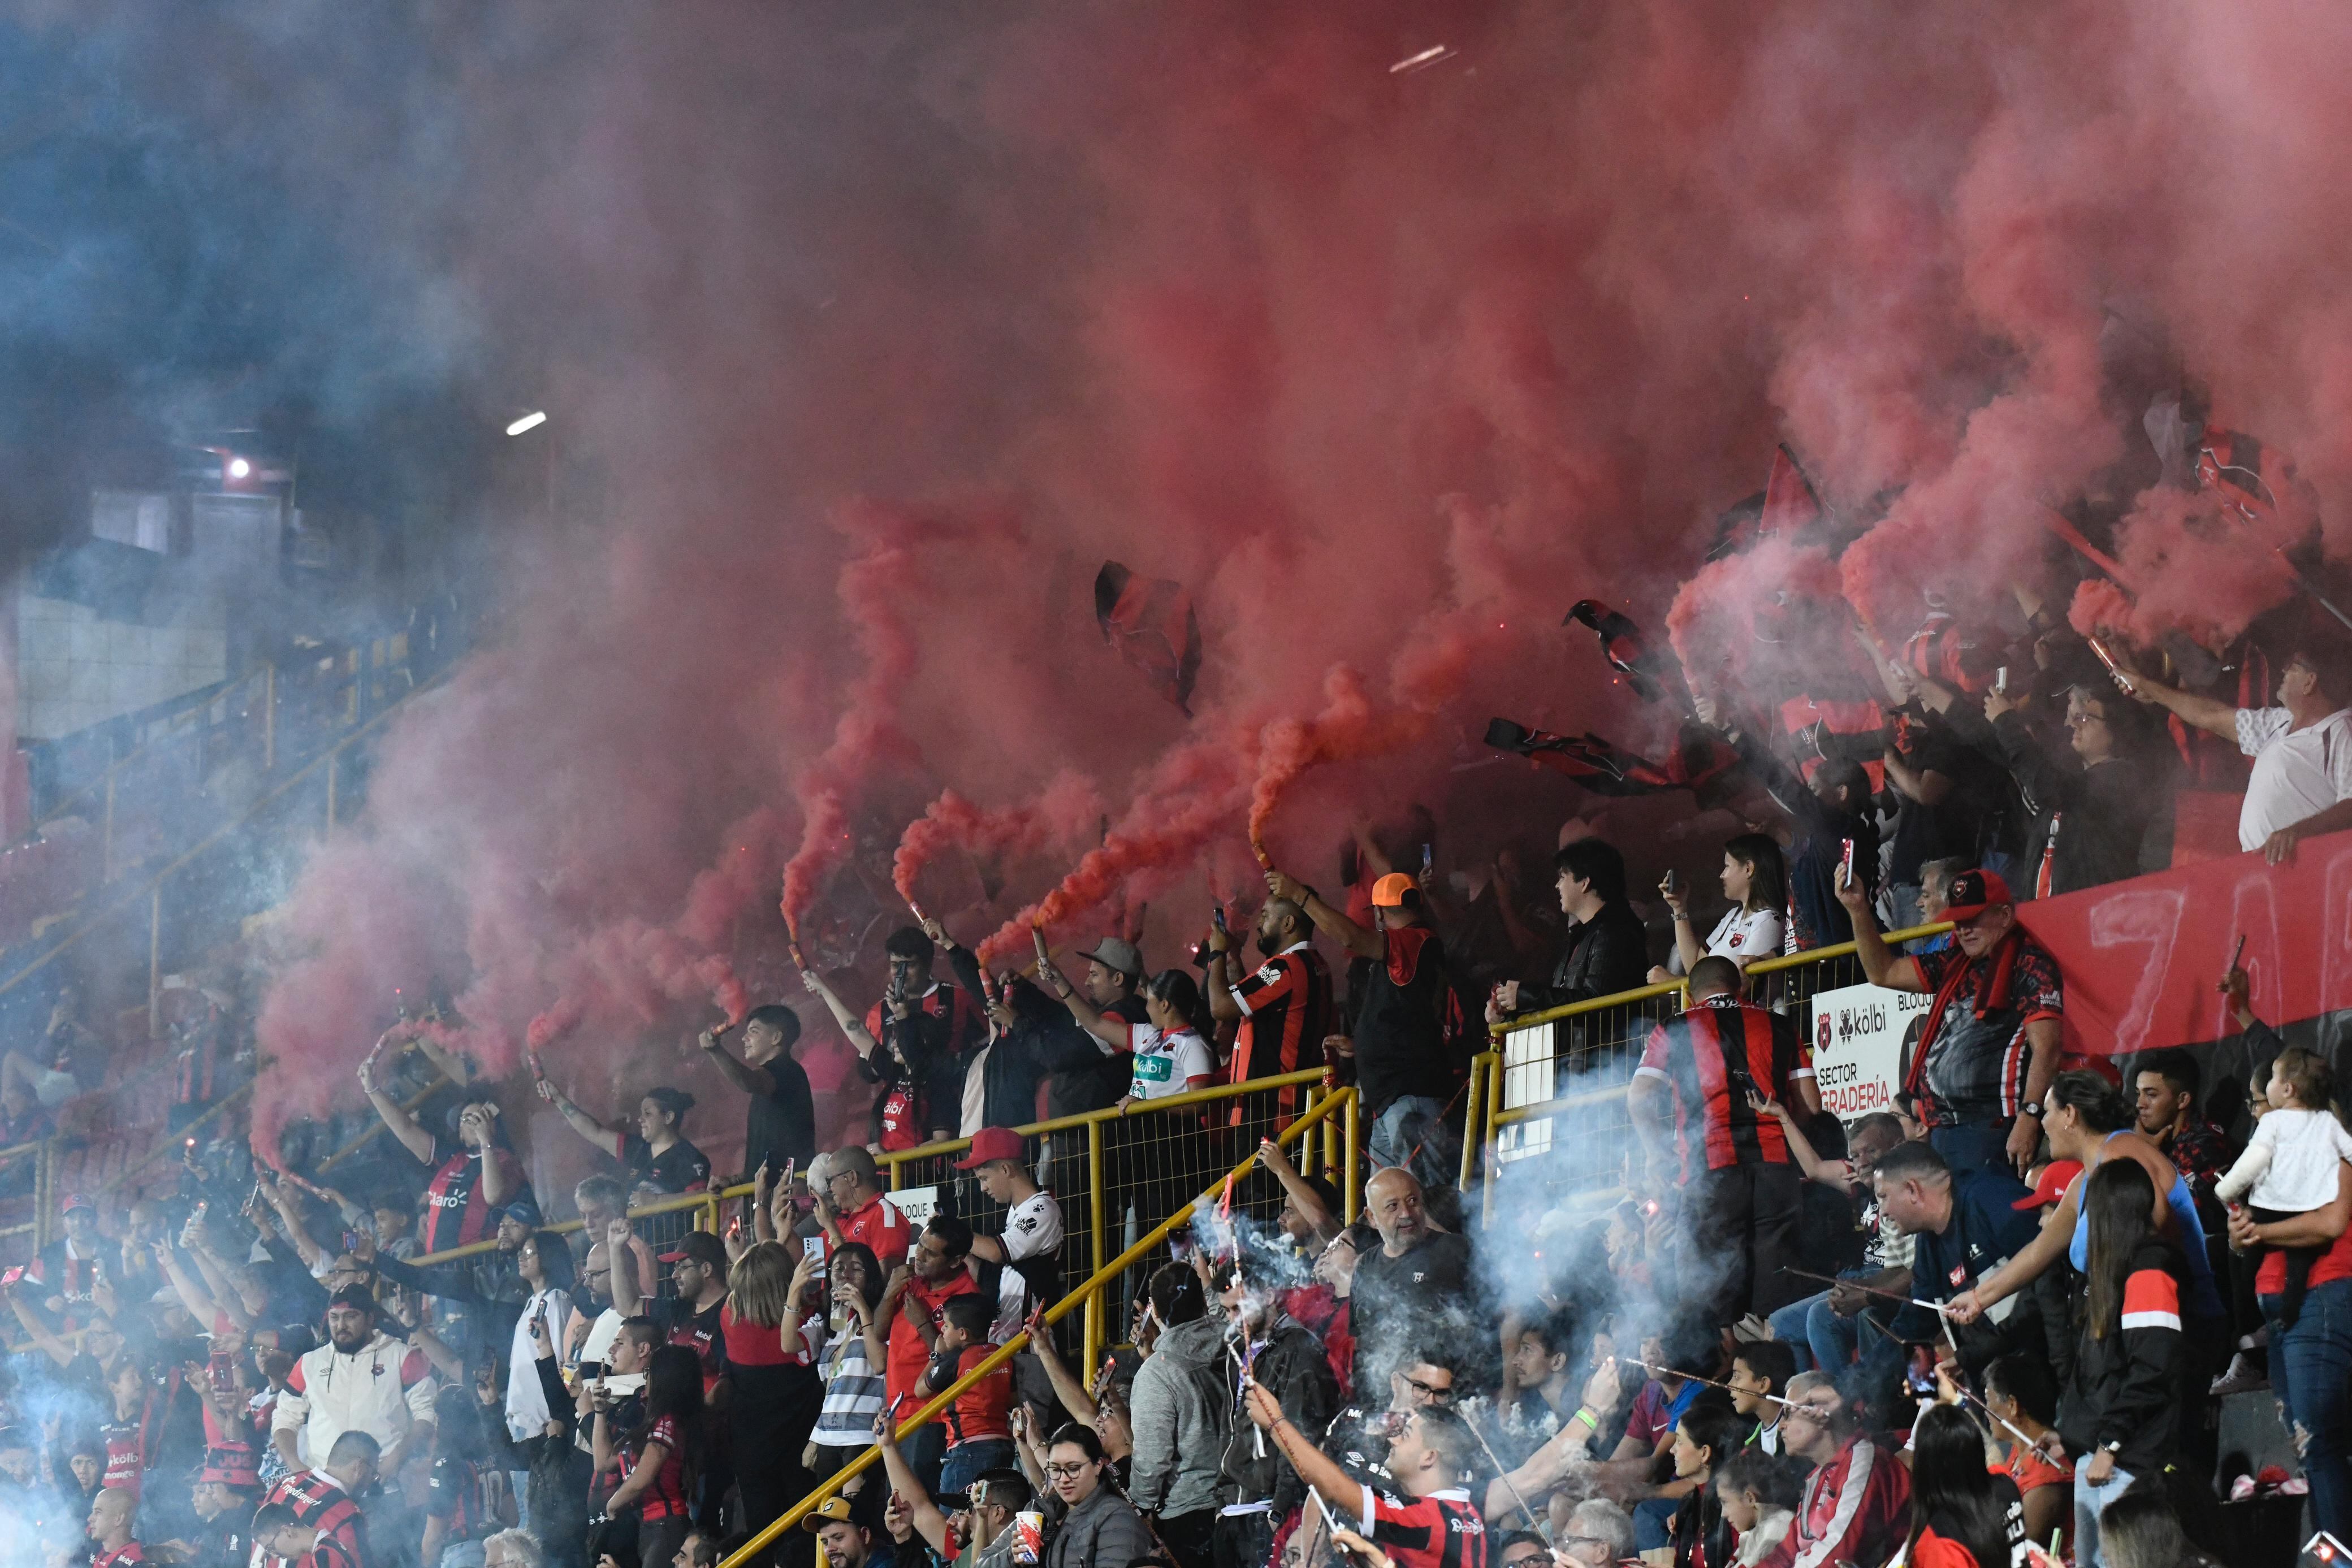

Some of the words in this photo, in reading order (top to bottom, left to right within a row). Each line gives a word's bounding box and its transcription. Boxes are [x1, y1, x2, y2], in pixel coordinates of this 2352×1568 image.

[1898, 993, 1936, 1012] BLOQU
[1853, 1003, 1887, 1037] kölbi
[1819, 1063, 1857, 1086] SECTOR
[1821, 1074, 1890, 1115] GRADERÍA
[884, 1101, 905, 1115] ölbi
[113, 1453, 139, 1466] kölb
[283, 1484, 323, 1506] medismart
